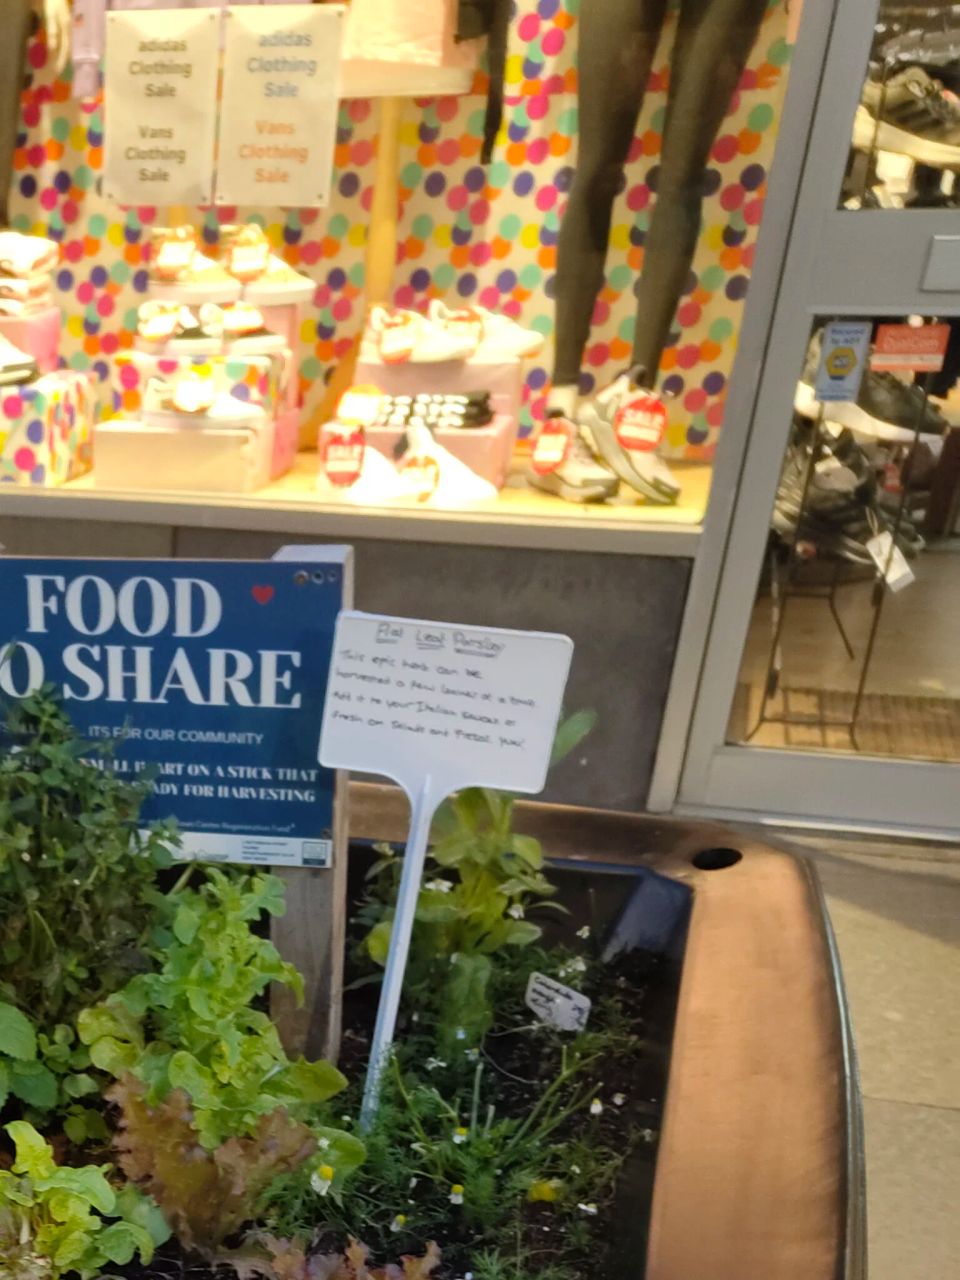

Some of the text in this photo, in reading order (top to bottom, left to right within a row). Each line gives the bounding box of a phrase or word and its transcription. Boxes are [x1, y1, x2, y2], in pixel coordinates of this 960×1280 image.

[128, 60, 193, 79] Clothing
[246, 56, 318, 77] Clothing
[144, 82, 177, 98] Sale
[263, 81, 300, 98] Sale
[138, 124, 175, 139] Vans
[254, 119, 296, 136] Vans
[124, 145, 187, 165] Clothing
[239, 143, 309, 165] Clothing
[138, 167, 170, 182] Sale
[254, 167, 289, 183] Sale
[24, 573, 223, 639] FOOD
[62, 642, 302, 709] SHARE
[88, 725, 111, 738] ITS
[144, 728, 176, 741] OUR
[177, 730, 264, 745] COMMUNITY
[187, 764, 210, 777] ON
[214, 765, 225, 778] A
[226, 765, 273, 780] STICK
[275, 768, 319, 783] THAT
[183, 783, 215, 798] FOR
[217, 785, 316, 803] HARVESTING
